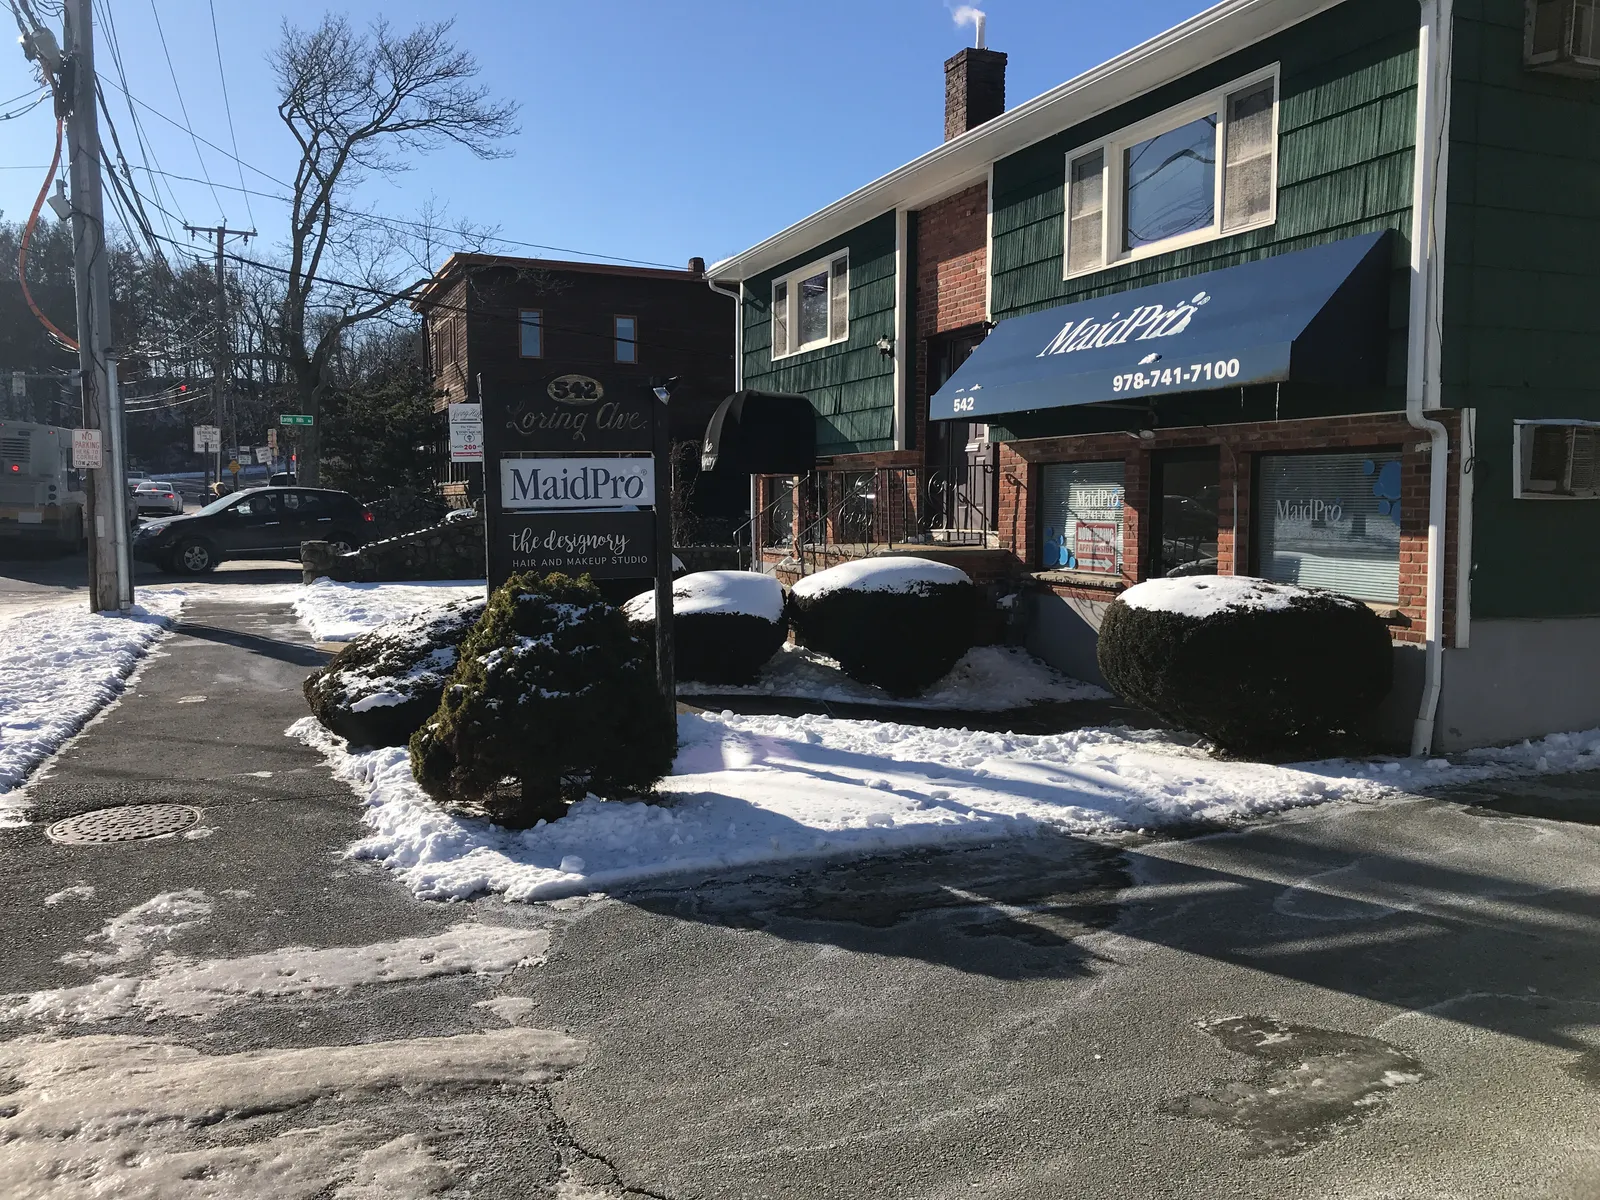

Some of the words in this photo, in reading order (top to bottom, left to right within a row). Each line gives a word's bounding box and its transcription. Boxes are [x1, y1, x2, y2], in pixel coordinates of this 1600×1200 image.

[1036, 303, 1198, 357] MaidPro
[1113, 358, 1240, 392] 978-741-7100
[553, 381, 599, 399] 542
[953, 396, 974, 412] 542
[506, 400, 589, 441] Loring
[75, 441, 100, 449] PARKING
[82, 432, 93, 440] NO
[510, 466, 644, 501] MaidPro
[1076, 489, 1119, 507] MaidPro
[1276, 499, 1342, 522] MaidPro
[509, 527, 541, 554] the
[543, 529, 630, 555] designory
[513, 560, 537, 568] HAIR
[541, 558, 563, 567] AND
[567, 556, 607, 566] MAKEUP
[612, 555, 648, 565] STUDIO
